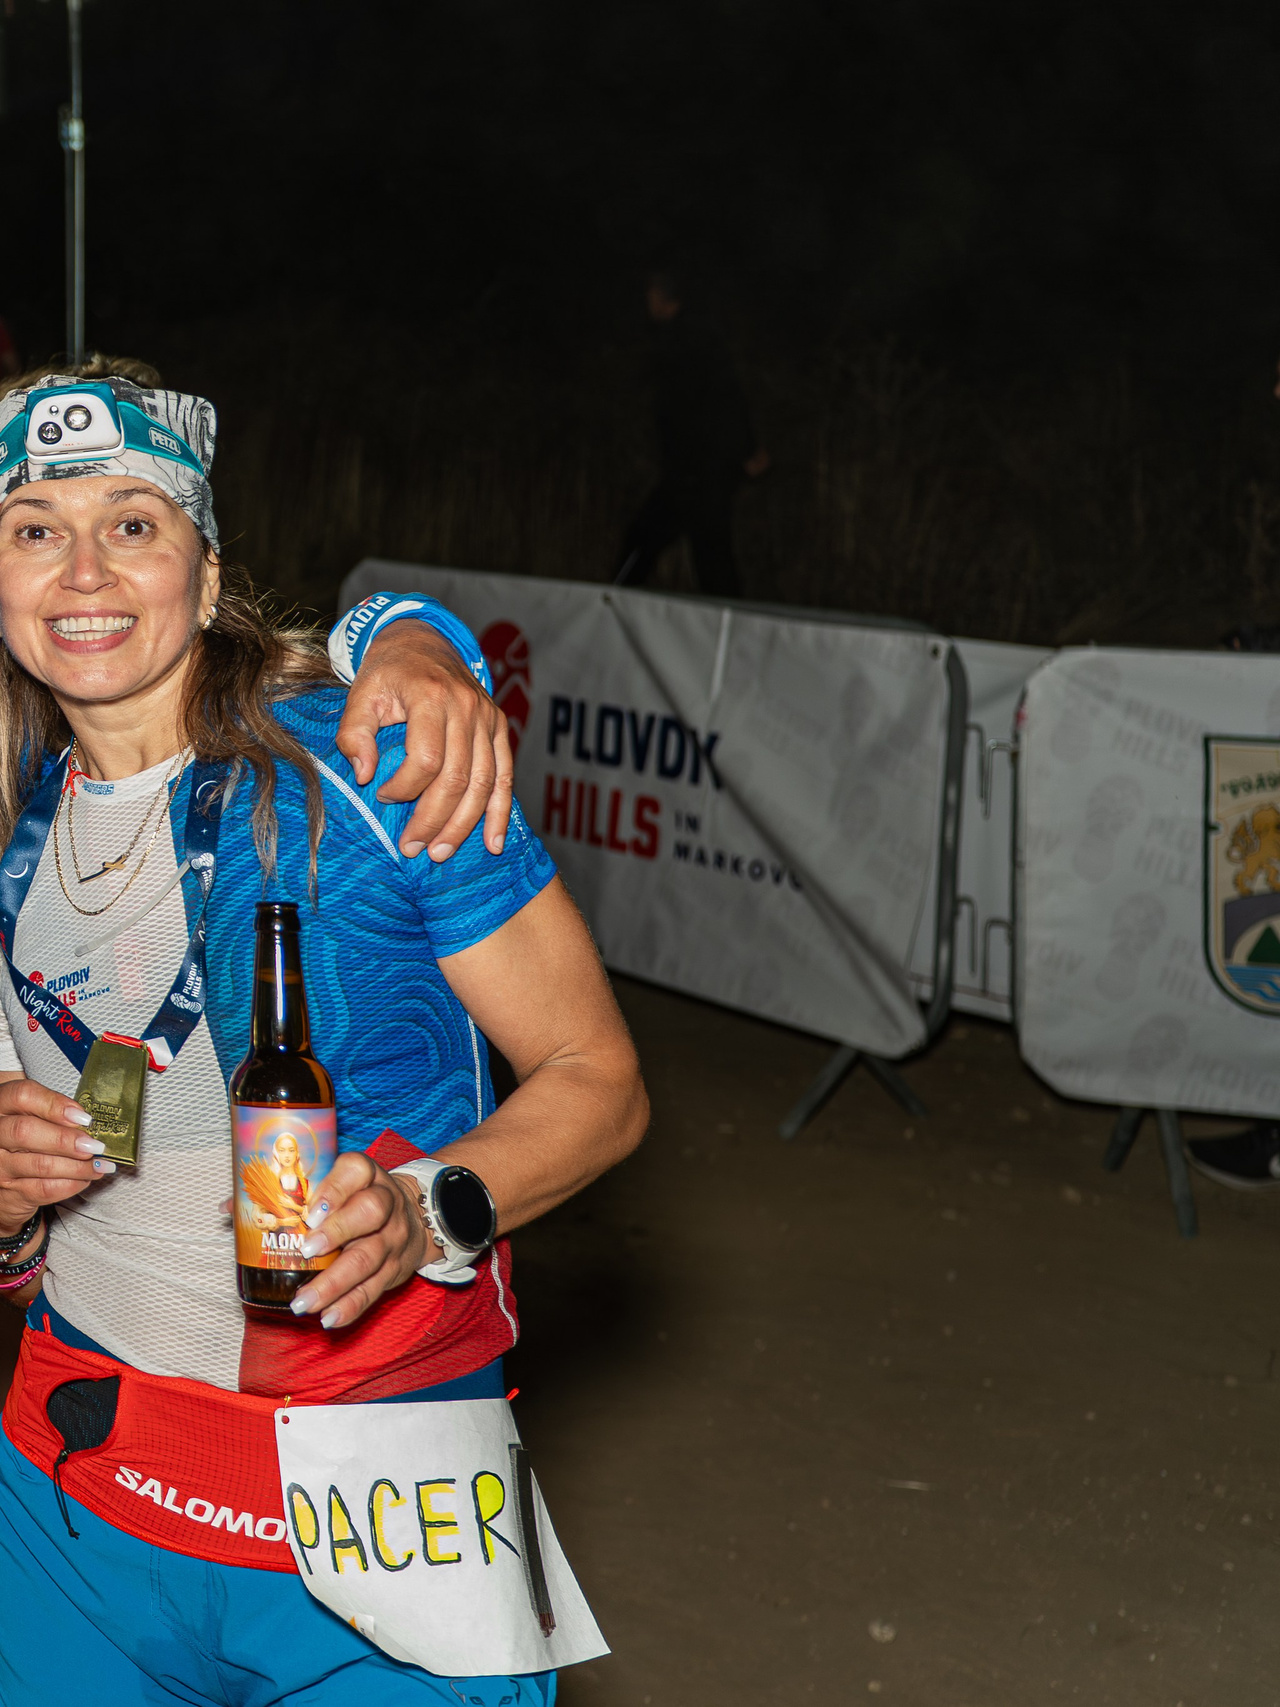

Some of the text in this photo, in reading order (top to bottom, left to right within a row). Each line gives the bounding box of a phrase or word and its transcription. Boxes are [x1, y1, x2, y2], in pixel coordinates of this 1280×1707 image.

[149, 428, 180, 455] PETZL
[543, 773, 661, 862] HILLS
[675, 810, 702, 833] IN
[46, 966, 90, 994] PLOVDIV
[182, 962, 199, 995] PLOVDIV
[190, 976, 203, 998] HILLS
[19, 985, 83, 1042] Night Run
[115, 1465, 291, 1543] SALOMO
[286, 1470, 520, 1577] PACER
